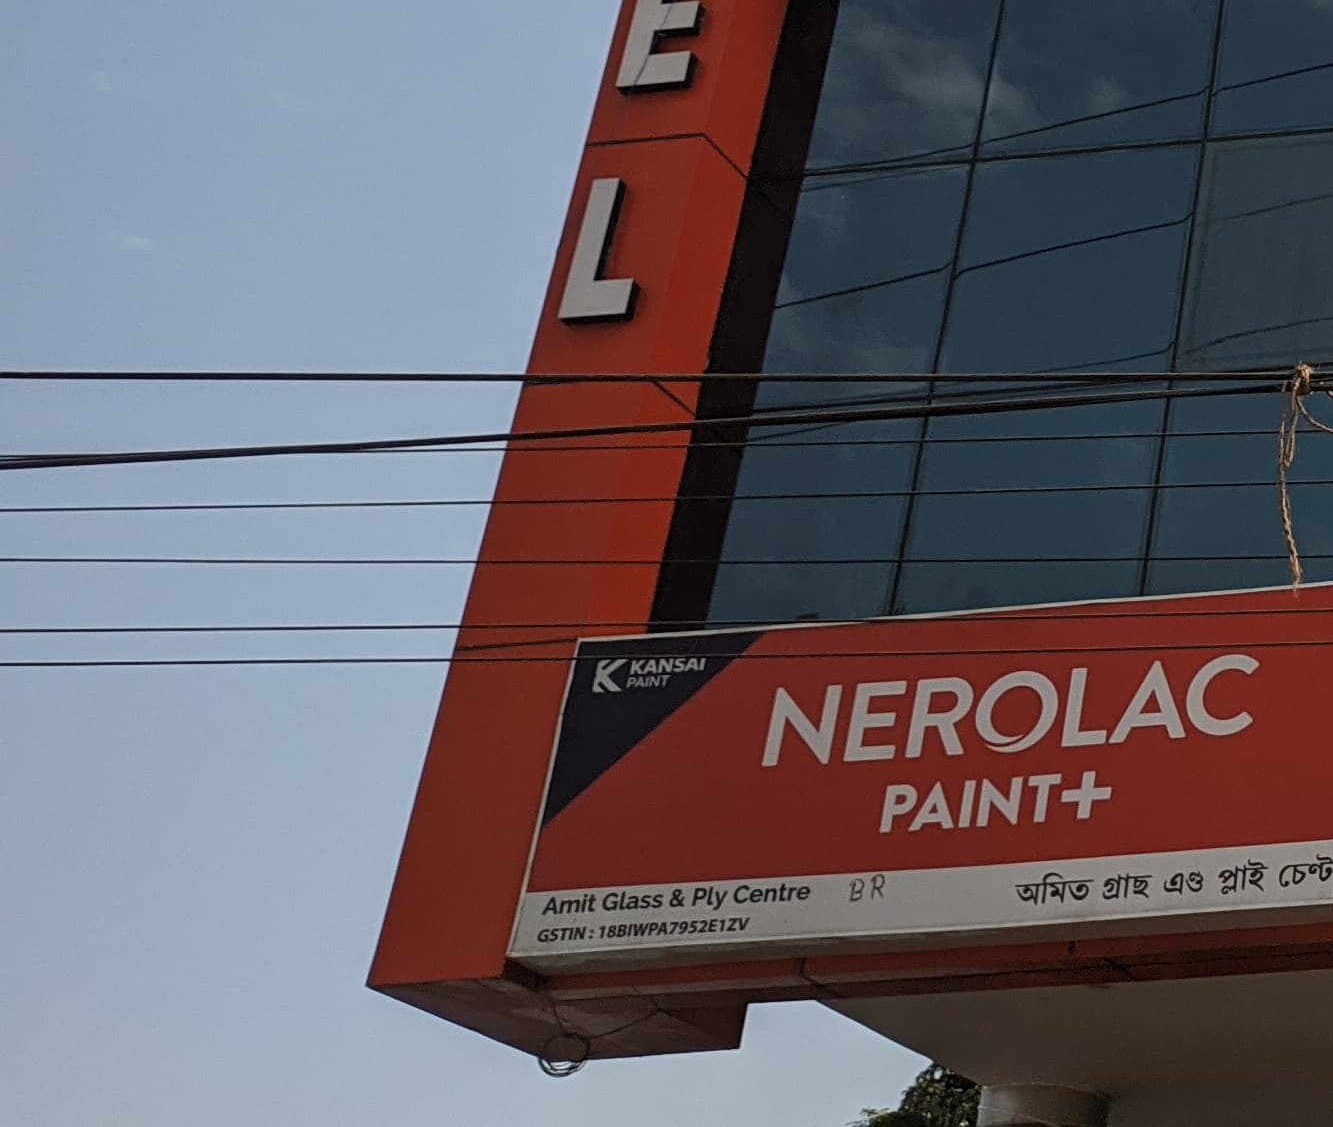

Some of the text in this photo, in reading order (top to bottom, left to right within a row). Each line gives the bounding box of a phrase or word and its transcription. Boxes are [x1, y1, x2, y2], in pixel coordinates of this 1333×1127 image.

[626, 674, 671, 688] PAINT
[629, 657, 707, 675] KANSAI
[760, 654, 1260, 767] NEROLAC
[878, 770, 1112, 834] PAINT+
[542, 882, 811, 915] Amit Glass & Ply Centre
[1015, 872, 1095, 905] অমিত
[599, 917, 751, 939] 18BIWPA7952E1ZV
